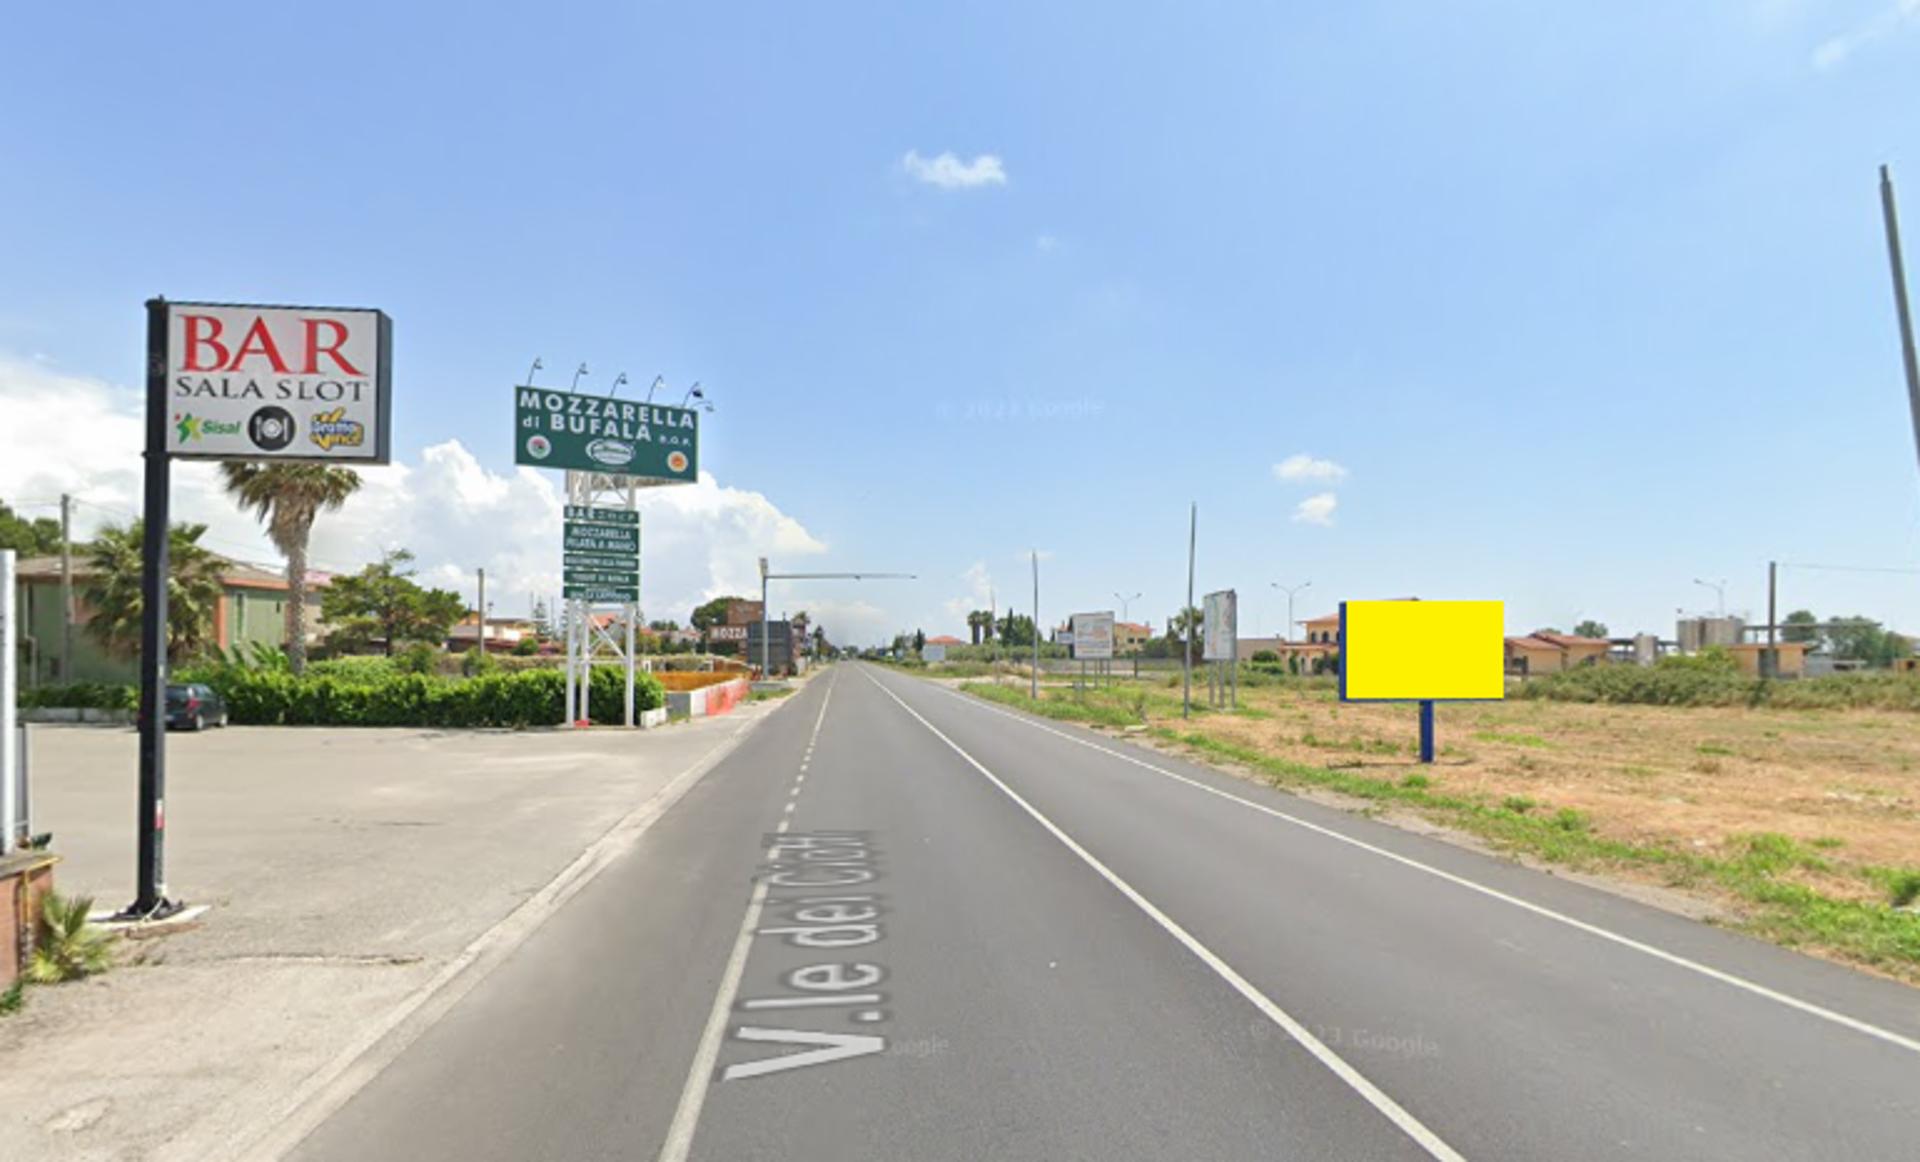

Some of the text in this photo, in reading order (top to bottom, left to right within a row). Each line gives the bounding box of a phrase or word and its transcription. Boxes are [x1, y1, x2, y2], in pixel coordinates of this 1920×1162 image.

[176, 313, 369, 377] BAR
[175, 376, 370, 402] SALA SLOT
[519, 391, 694, 430] MOZZARELLA
[201, 419, 241, 435] Sisal
[522, 413, 652, 442] di BUFALA
